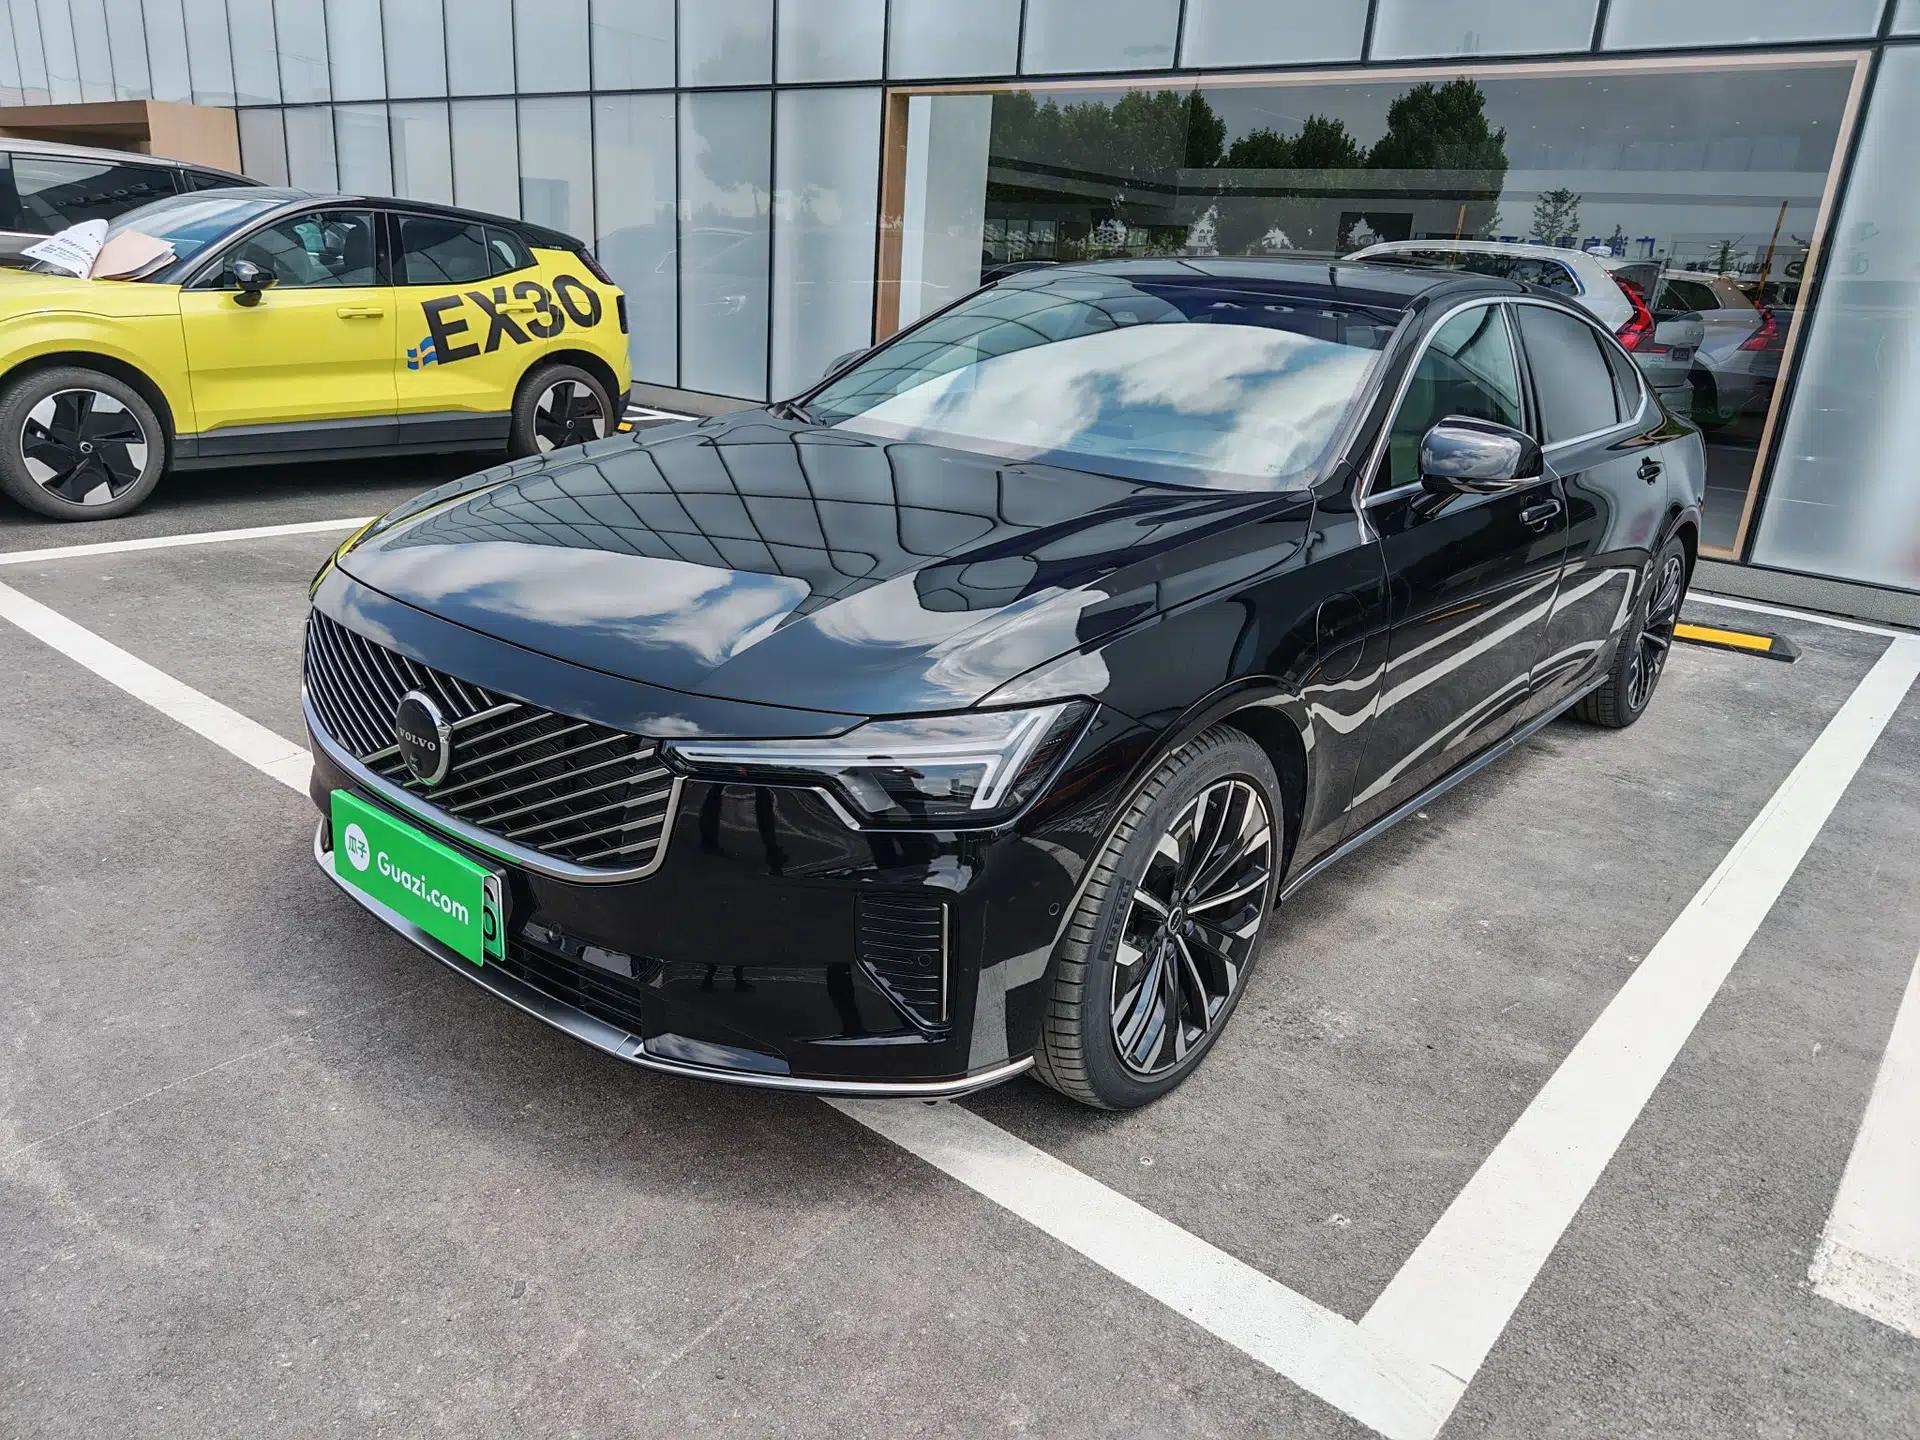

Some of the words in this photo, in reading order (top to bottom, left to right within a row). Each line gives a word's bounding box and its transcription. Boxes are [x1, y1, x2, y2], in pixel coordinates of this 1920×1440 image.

[421, 274, 602, 365] EX30
[399, 727, 436, 752] VOLVO
[348, 834, 367, 858] 瓜子
[377, 851, 469, 926] Guazi.com
